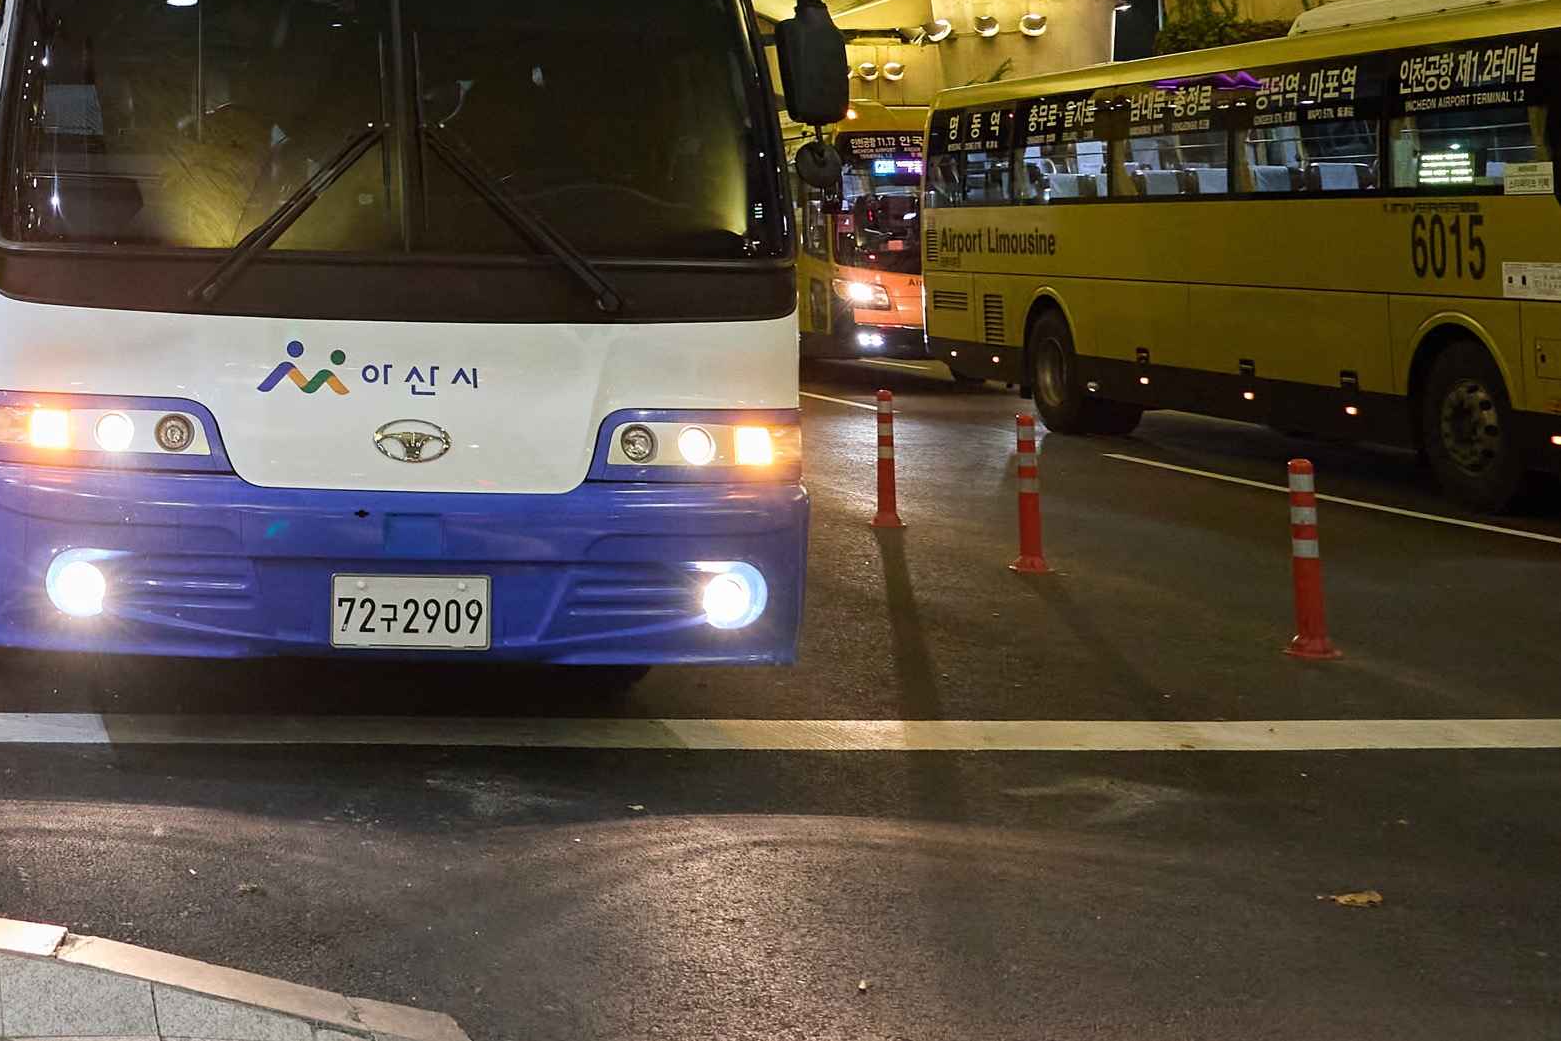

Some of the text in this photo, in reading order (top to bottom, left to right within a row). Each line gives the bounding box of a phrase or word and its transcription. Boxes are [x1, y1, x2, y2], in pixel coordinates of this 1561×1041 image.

[1399, 52, 1453, 94] 인천공항
[1405, 98, 1437, 113] INCHEON
[1438, 93, 1471, 109] AIRPORT
[1472, 90, 1512, 106] TERMINAL
[940, 227, 1056, 256] Airport Limousine
[1411, 214, 1486, 280] 6015
[337, 597, 483, 635] 72구2909
